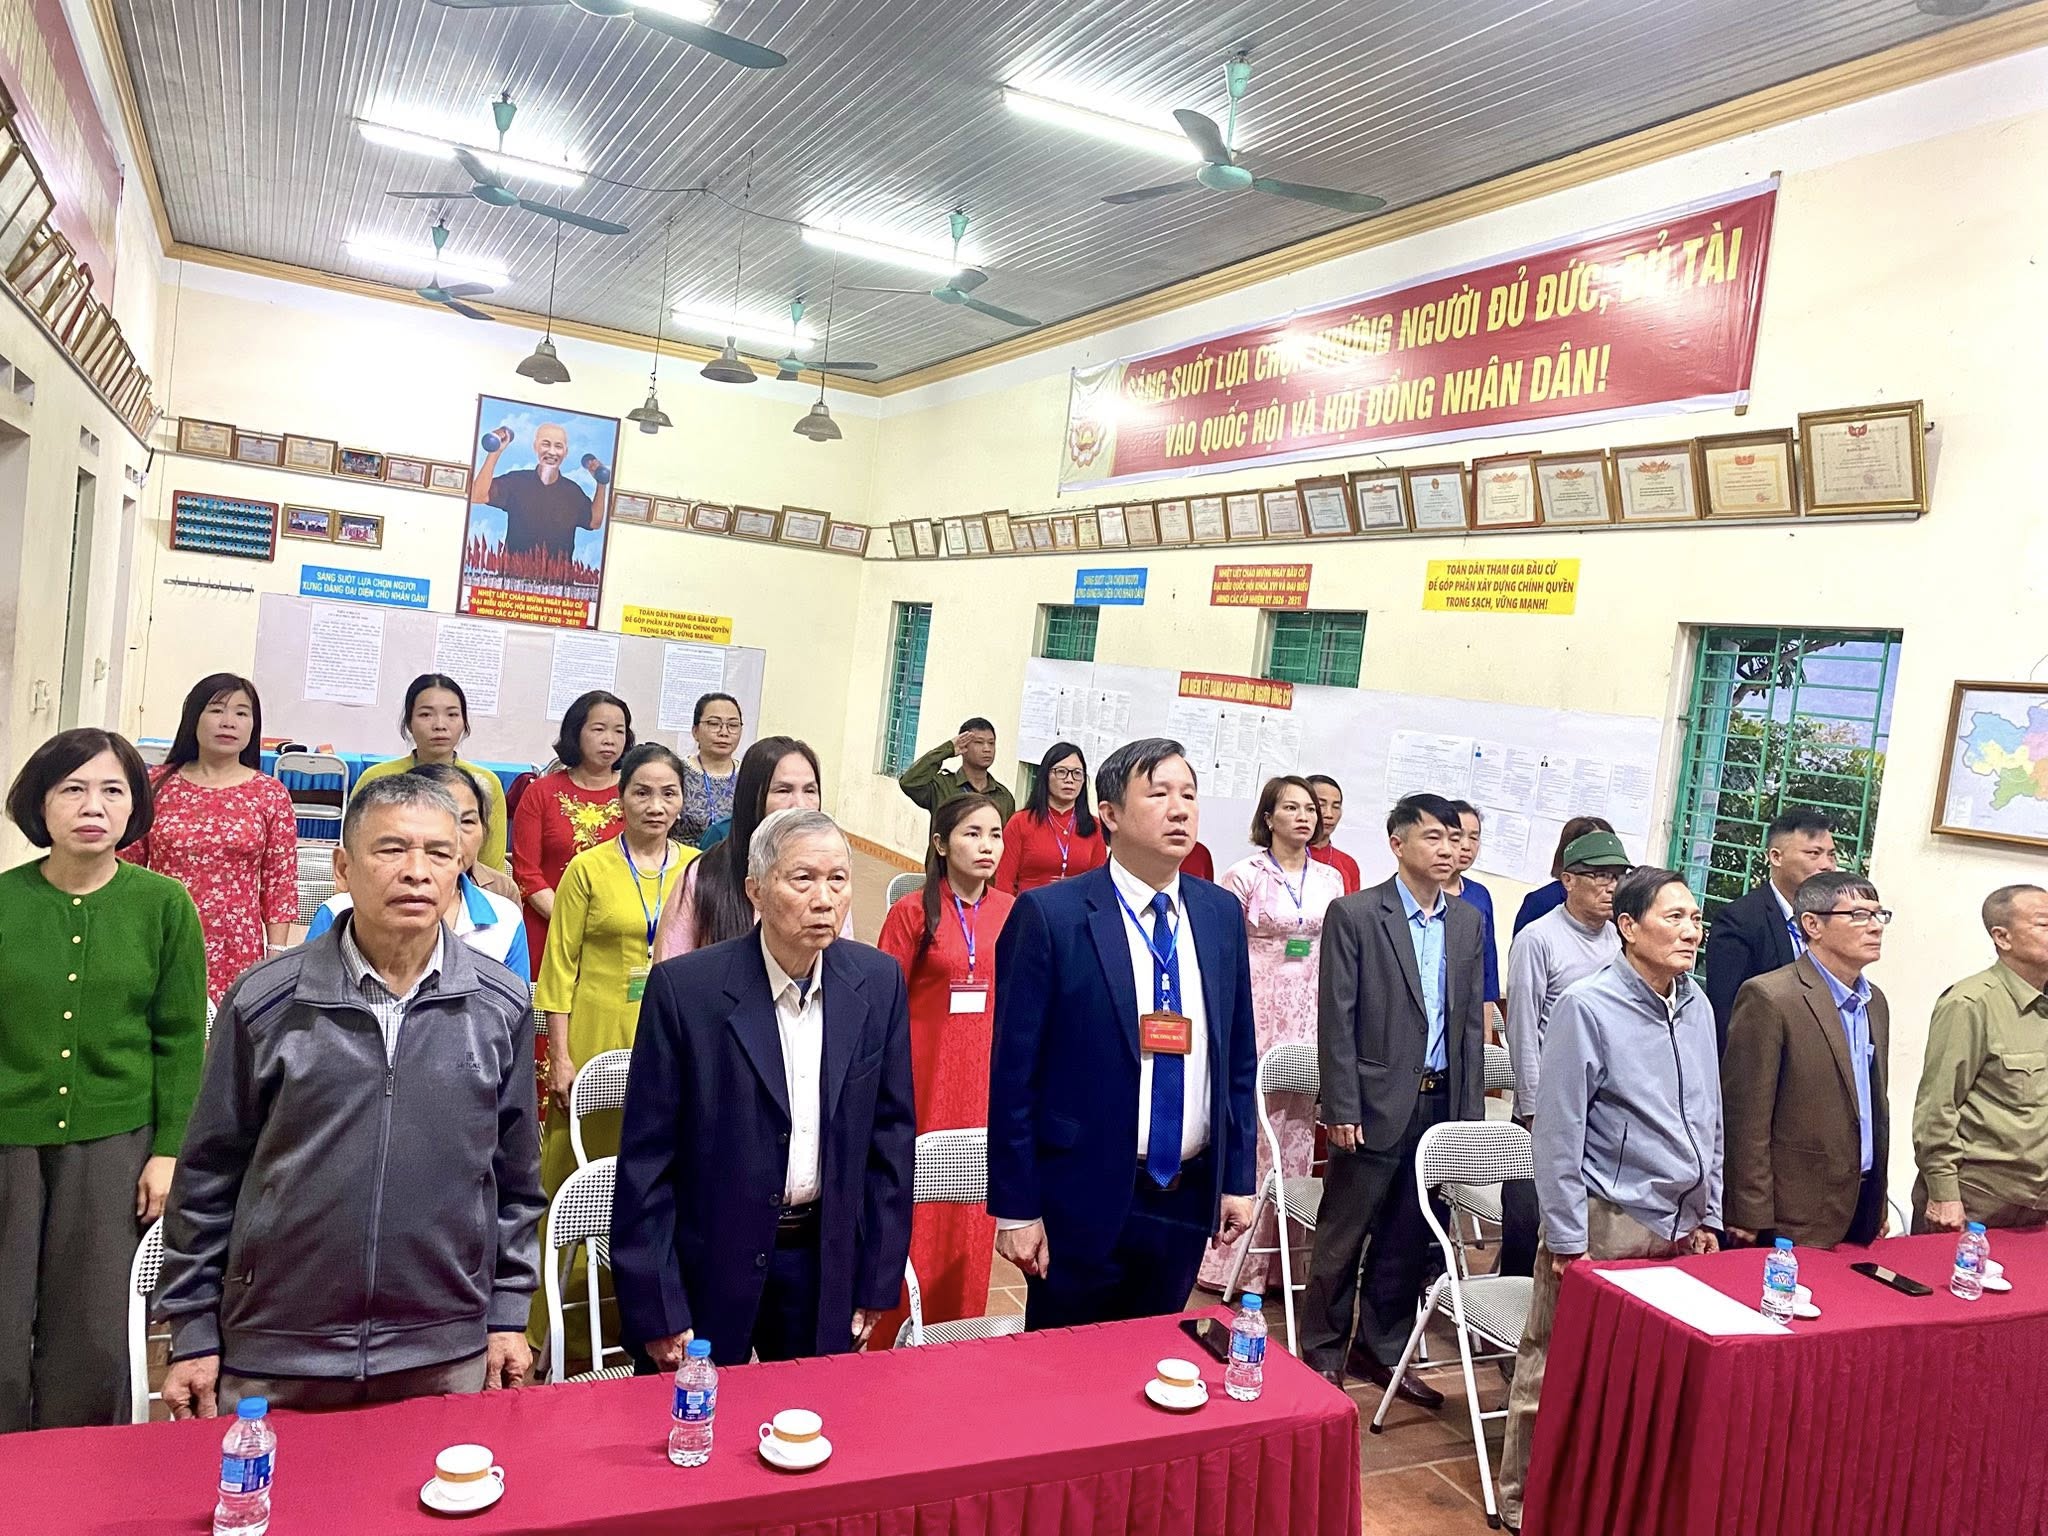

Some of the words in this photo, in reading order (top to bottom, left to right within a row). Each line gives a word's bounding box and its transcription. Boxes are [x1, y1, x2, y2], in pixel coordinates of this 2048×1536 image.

[1169, 347, 1213, 399] SUỐT
[1215, 347, 1249, 396] LỰA
[1397, 284, 1482, 351] NGƯỜI
[1486, 265, 1530, 333] ĐỦ
[1534, 258, 1609, 322] ĐỨC,
[1680, 221, 1744, 289] TÀI
[1165, 416, 1197, 458] VÀO
[1199, 399, 1249, 457] QUỐC
[1251, 397, 1286, 451] HỘI
[1291, 390, 1317, 437] VÀ
[1321, 385, 1362, 440] HỘI
[1365, 368, 1436, 428] ĐỒNG
[1440, 355, 1524, 417] NHÂN
[1529, 341, 1611, 403] DÂN!
[1446, 561, 1467, 575] TOÀN
[1468, 561, 1485, 575] DÂN
[1486, 564, 1510, 575] THAM
[1510, 564, 1525, 575] GIA
[1526, 559, 1544, 575] BẦU
[1544, 559, 1558, 575] CỬ
[1438, 577, 1454, 591] GÓP
[1454, 577, 1476, 591] PHẦN
[1476, 577, 1493, 592] XÂY
[1493, 579, 1517, 595] DỰNG
[1517, 577, 1545, 593] CHÍNH
[1545, 577, 1575, 594] QUYỀN
[1445, 596, 1470, 608] TRONG
[1495, 594, 1518, 609] VỮNG
